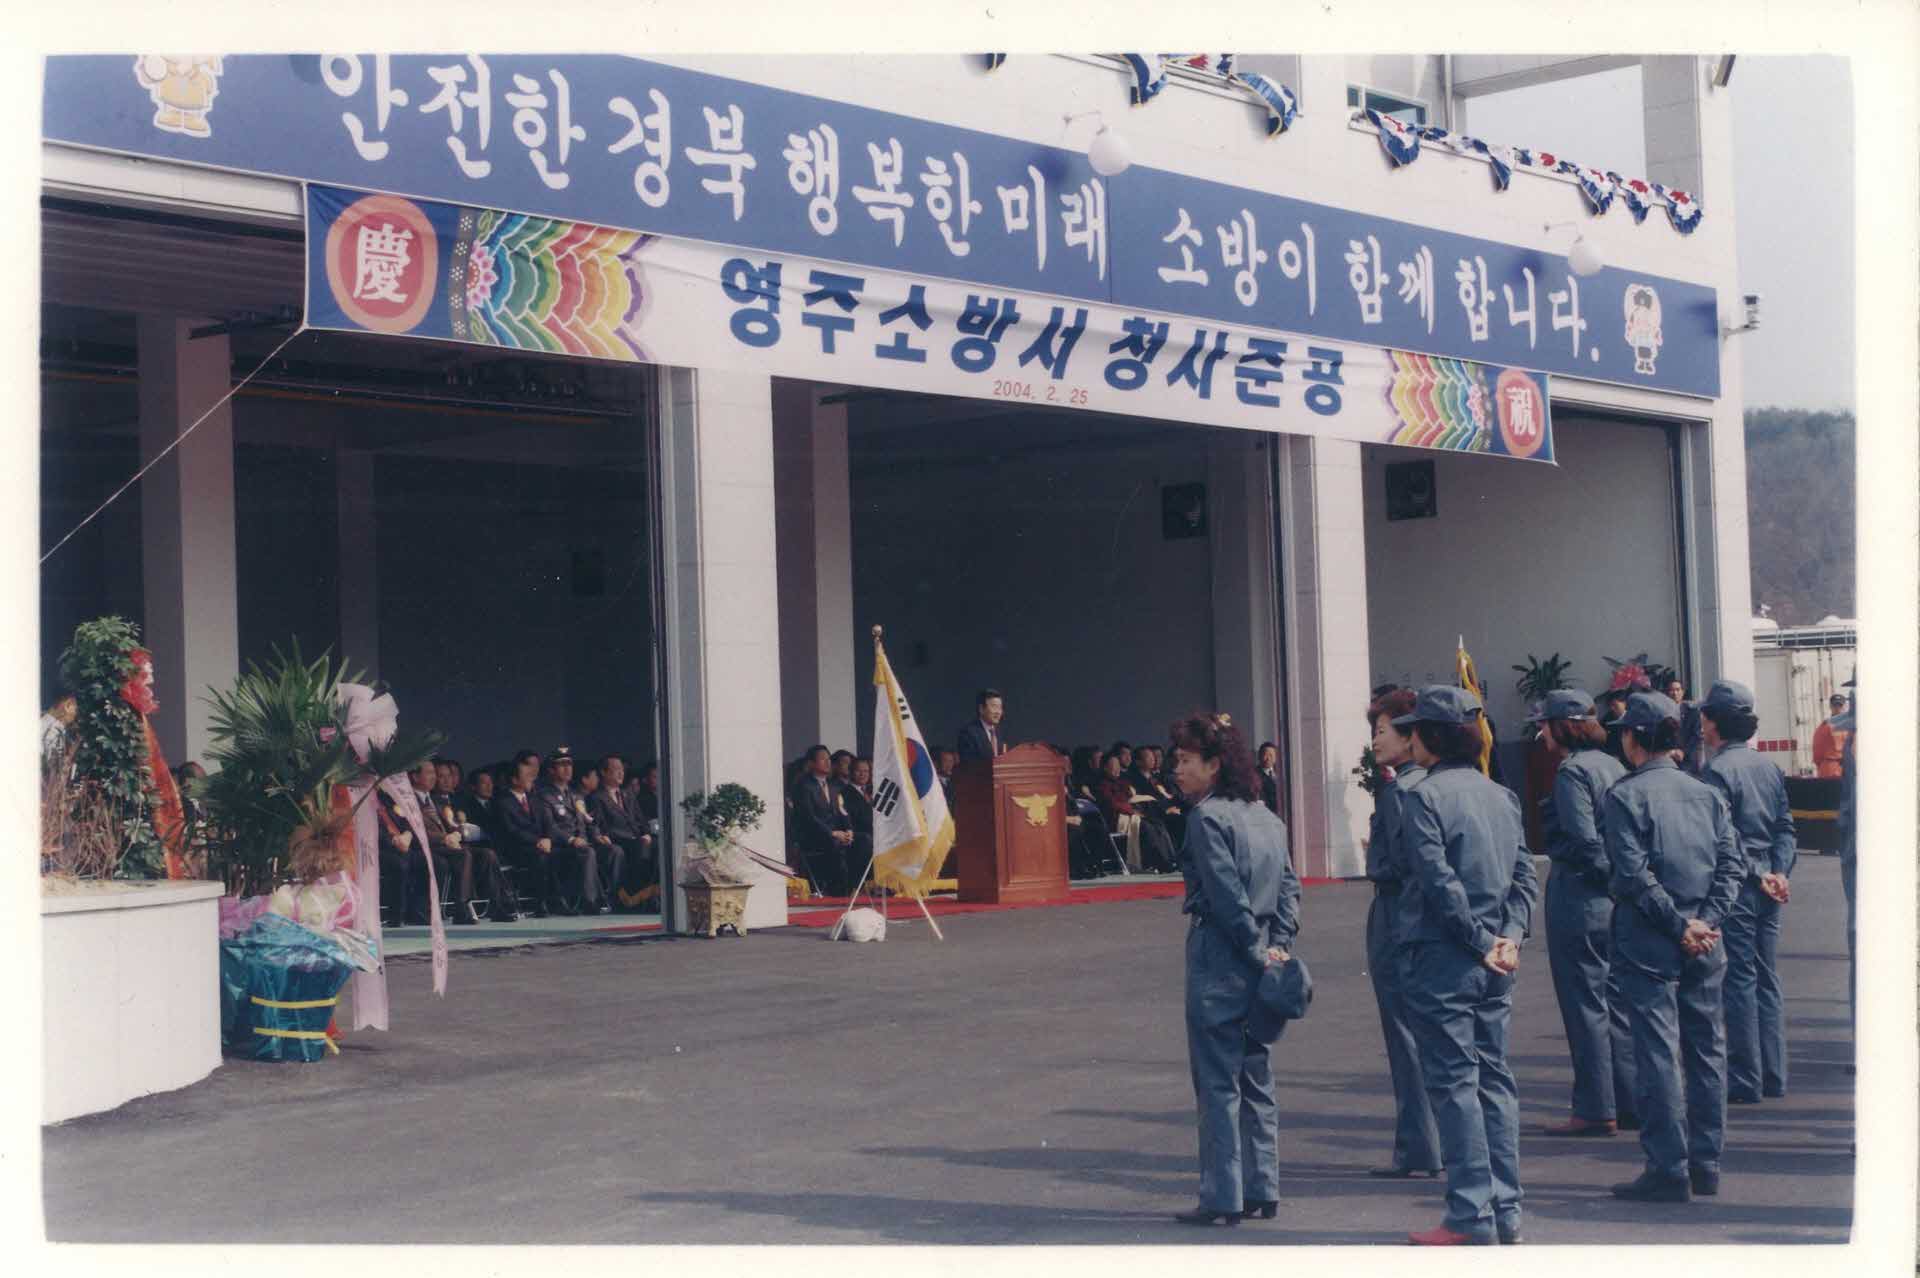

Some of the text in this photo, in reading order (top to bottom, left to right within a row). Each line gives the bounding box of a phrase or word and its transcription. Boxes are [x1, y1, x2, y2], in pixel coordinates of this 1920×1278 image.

[320, 54, 1601, 363] 안전한 경북 행복한 미래 소방이 함께 합니다.
[353, 223, 414, 304] 慶
[720, 257, 1345, 416] 영주소방서 청사준공
